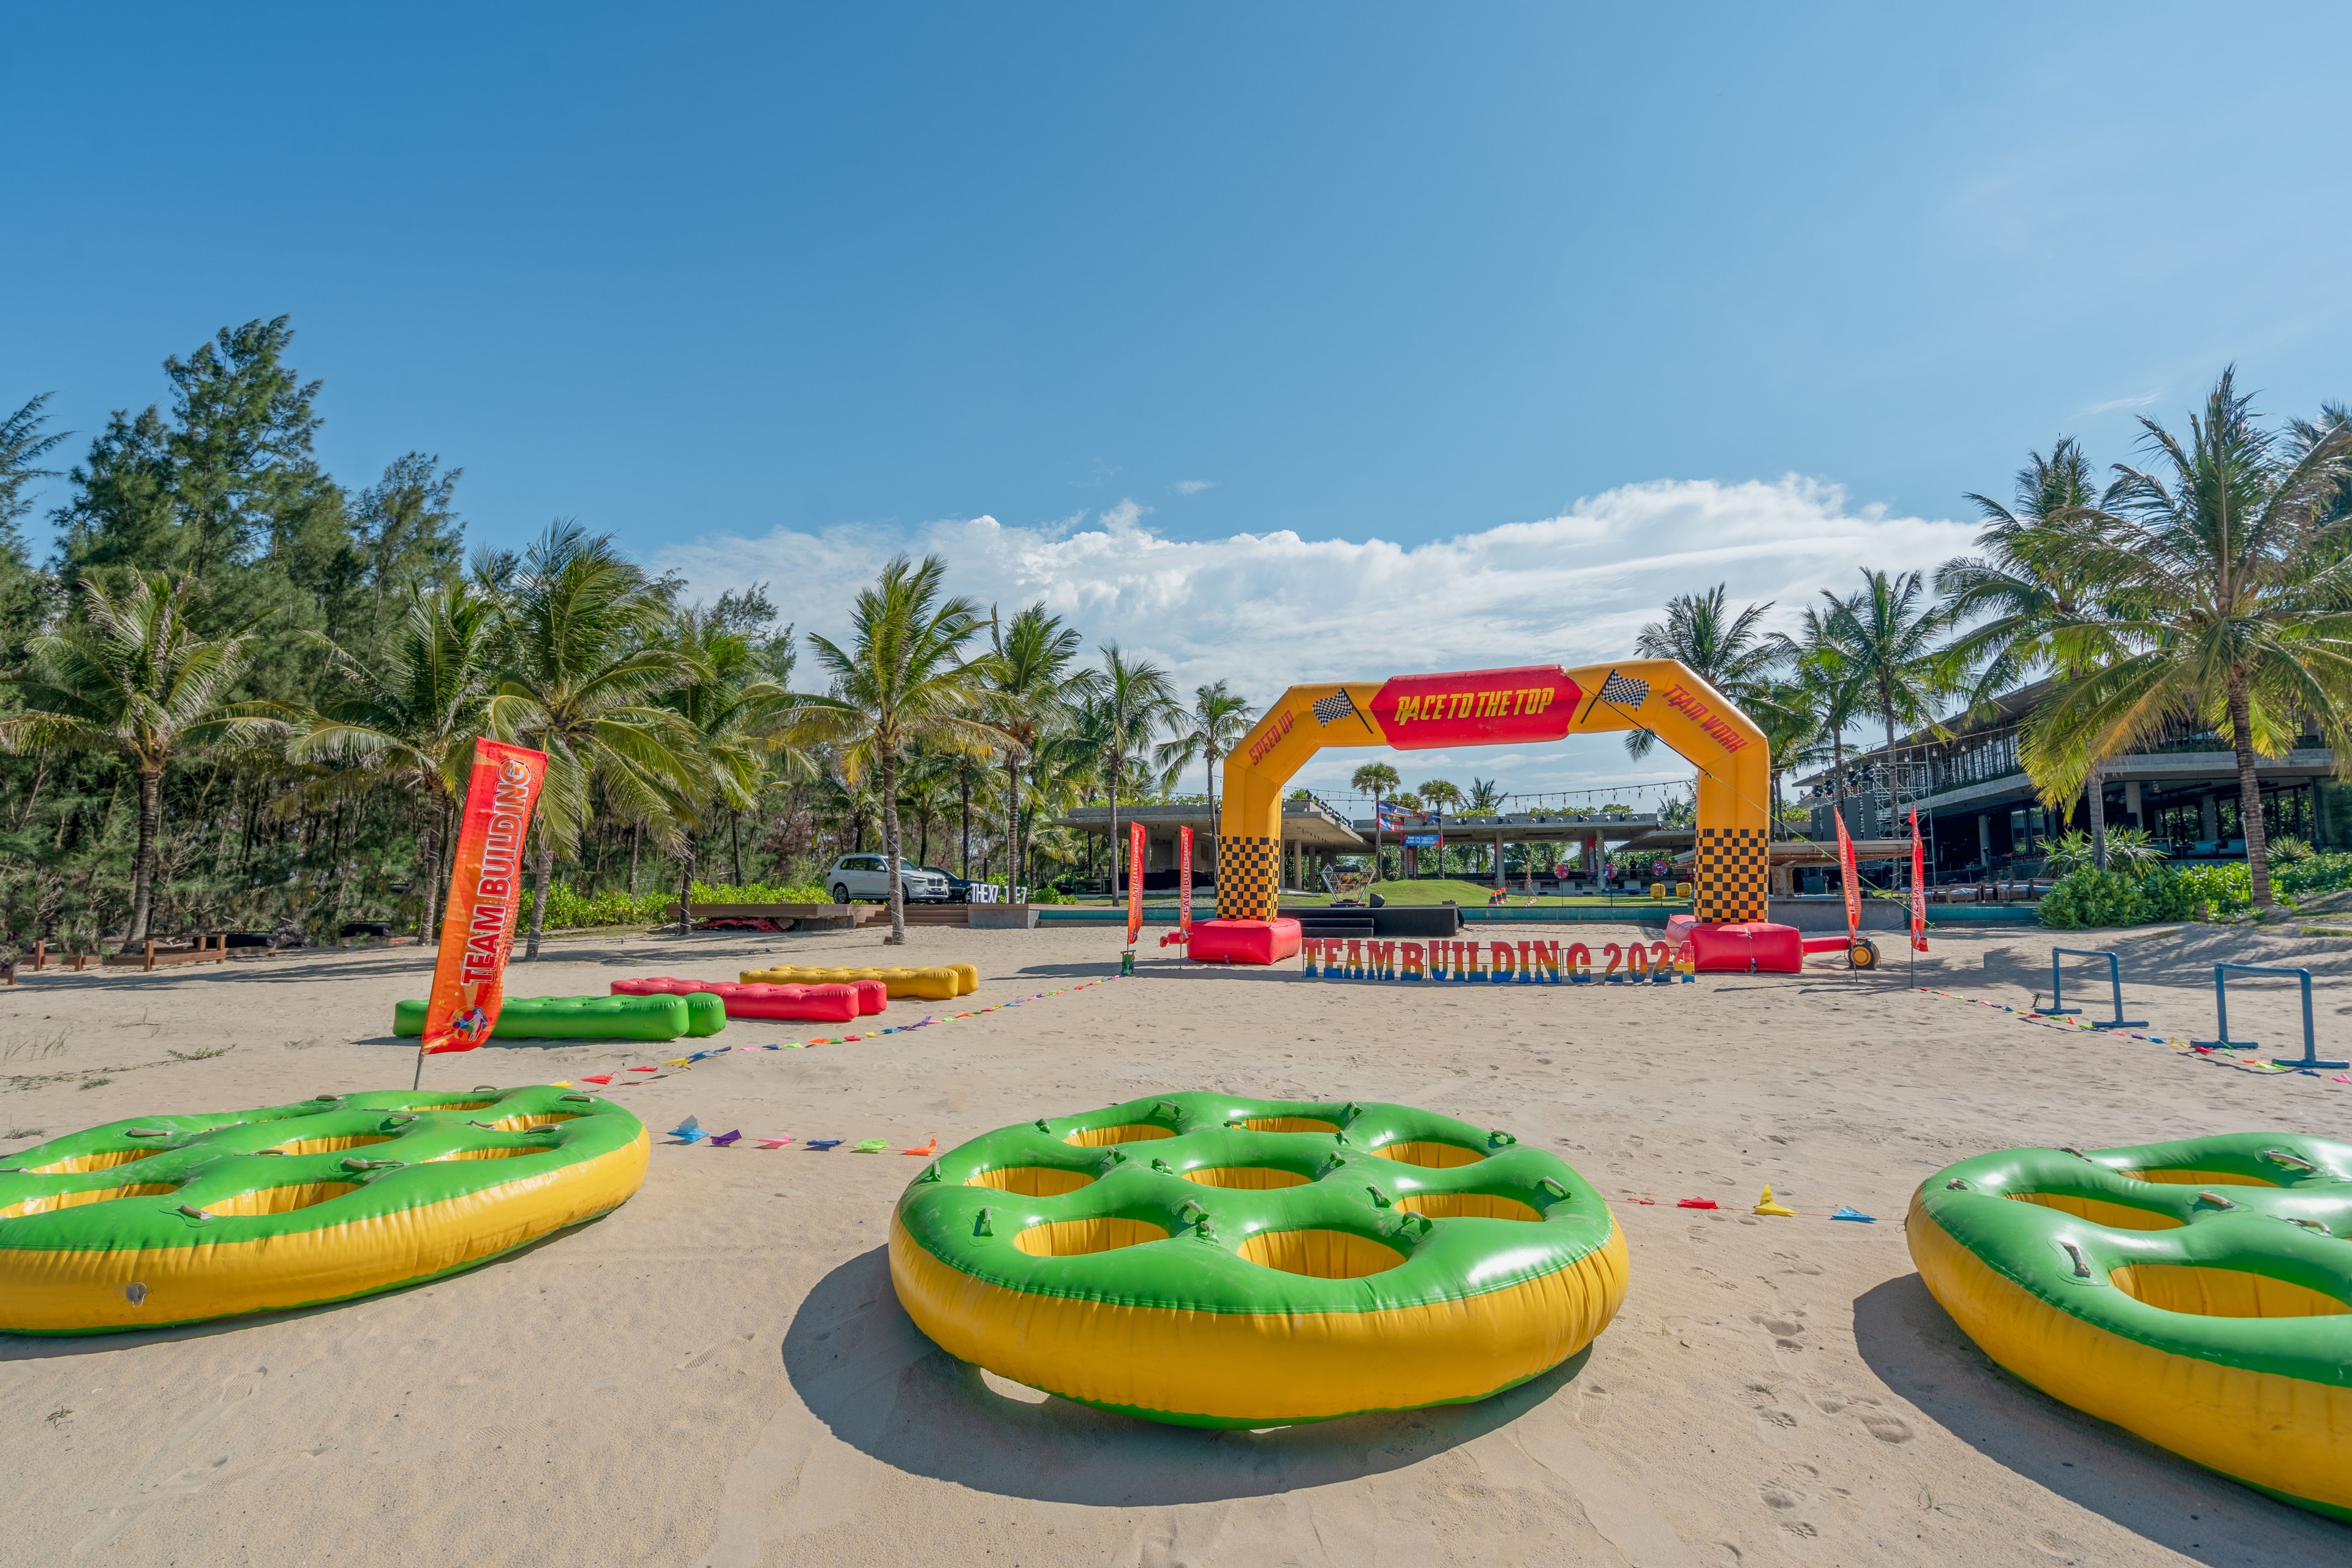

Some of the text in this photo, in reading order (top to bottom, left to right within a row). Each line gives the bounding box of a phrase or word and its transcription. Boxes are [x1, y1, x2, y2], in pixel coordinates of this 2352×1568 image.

[1393, 687, 1555, 726] RACE TO THE TOP
[1662, 684, 1749, 754] TEAM WORK
[1248, 709, 1294, 766] SPEED UP
[461, 758, 532, 986] TEAM BUILDING
[970, 883, 999, 903] THE X7
[1004, 885, 1027, 904] TE 7
[1182, 889, 1191, 920] TEAM
[1602, 940, 1695, 983] 2024
